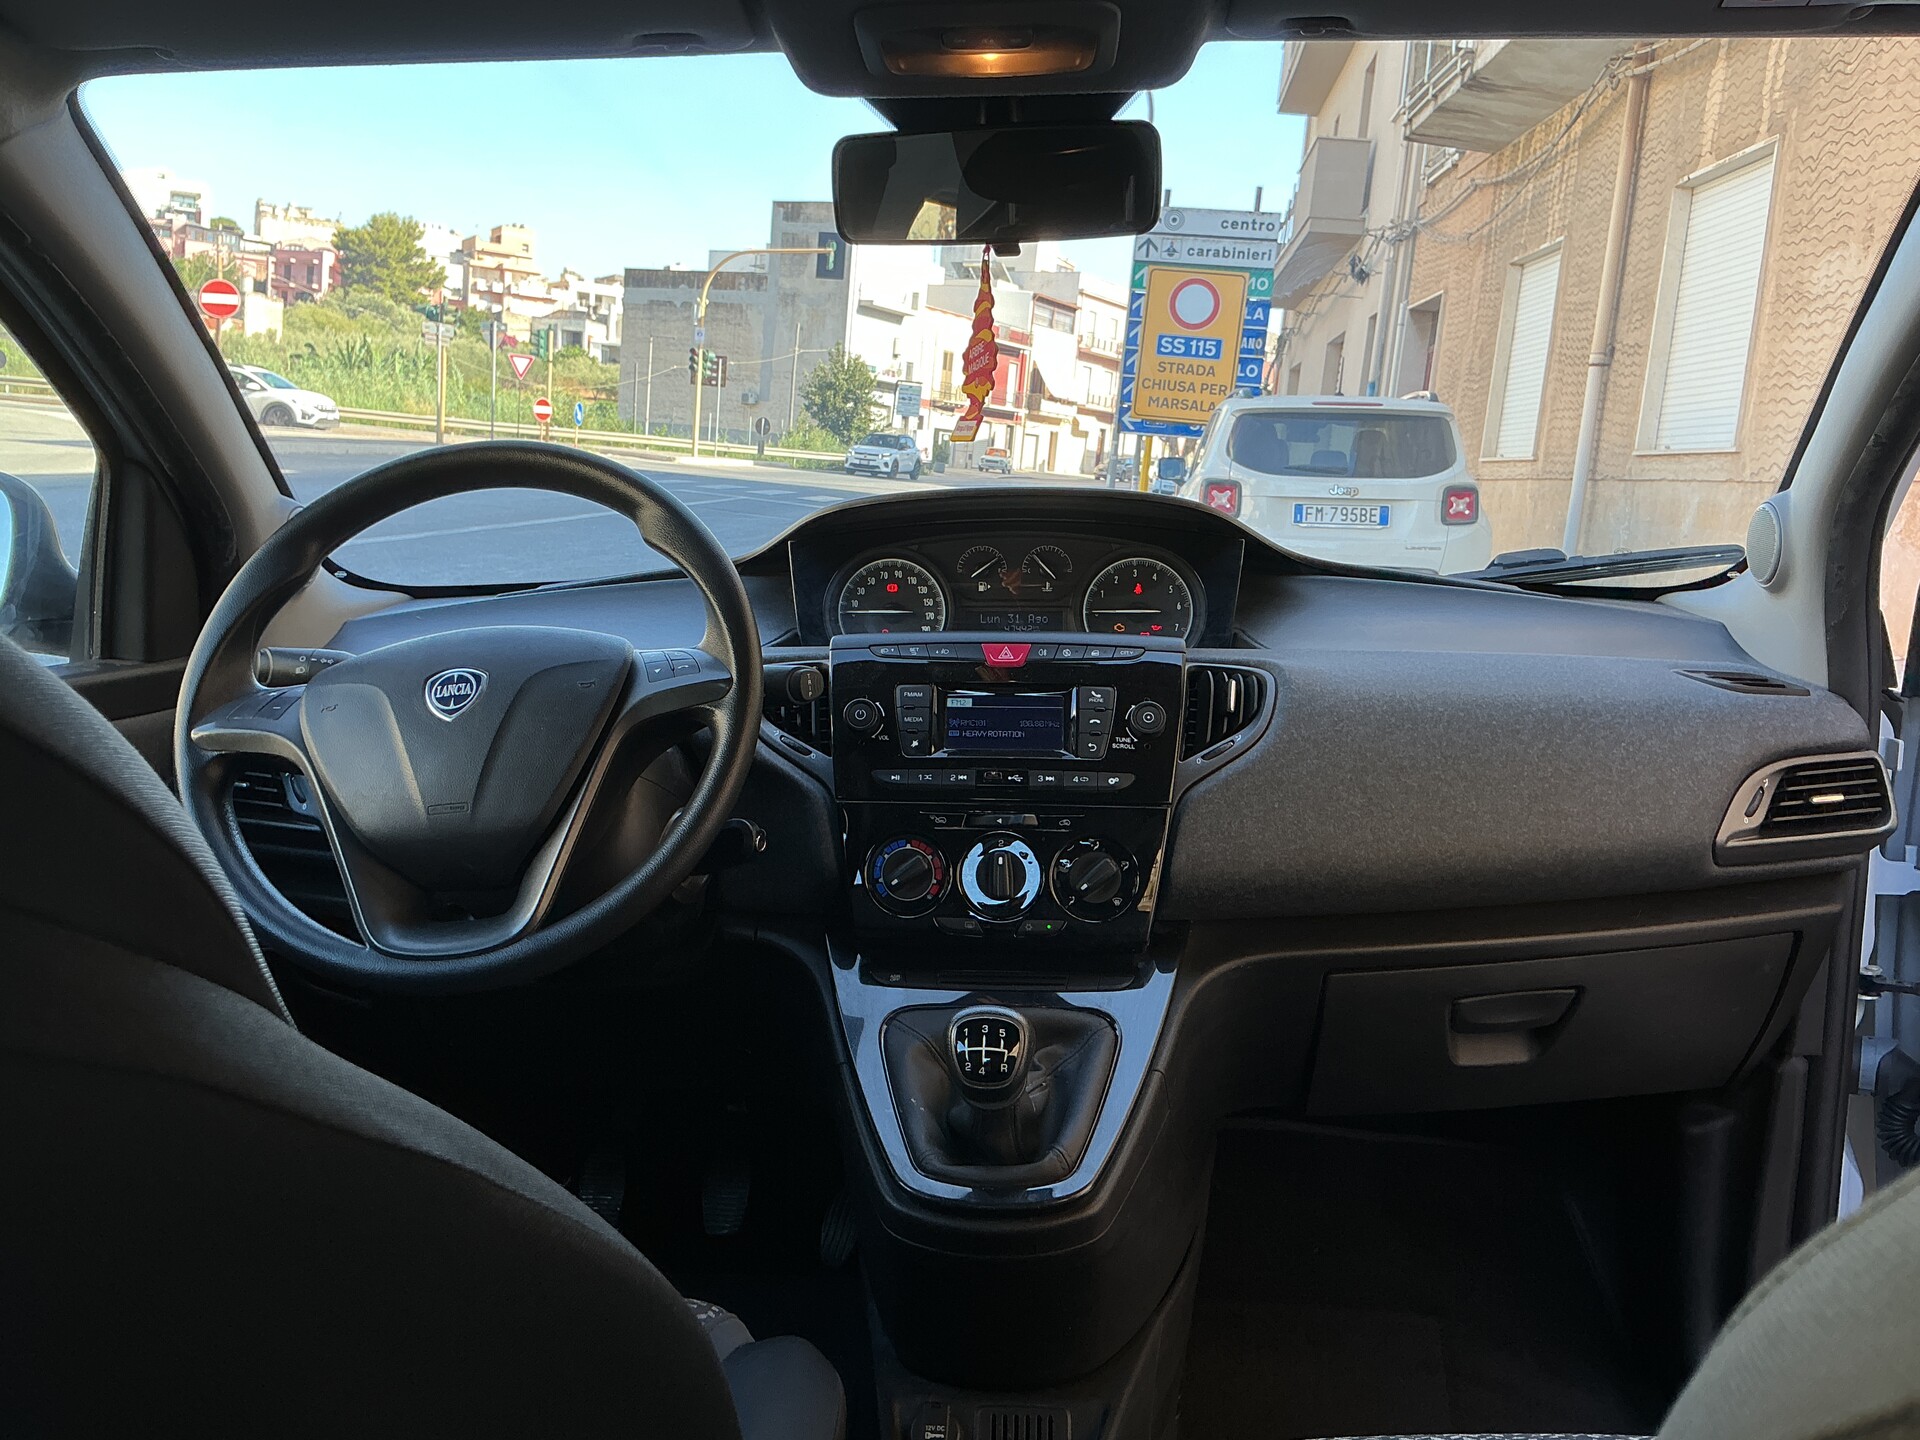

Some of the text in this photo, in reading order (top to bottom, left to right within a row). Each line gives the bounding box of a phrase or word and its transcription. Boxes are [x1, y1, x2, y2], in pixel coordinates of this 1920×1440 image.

[1220, 219, 1276, 231] centro
[1187, 246, 1272, 261] carabinieri
[1160, 337, 1217, 356] SS 115
[1157, 361, 1215, 377] STRADA
[1142, 378, 1228, 397] CHIUSA PER
[1147, 396, 1217, 412] MARSALA
[1329, 484, 1359, 497] Jeep
[894, 570, 902, 578] 90
[1133, 569, 1137, 578] 3
[1152, 573, 1157, 581] 4
[908, 576, 917, 585] 110
[1114, 576, 1118, 584] 2
[1169, 585, 1173, 593] 5
[1177, 602, 1181, 610] 6
[980, 614, 1000, 623] Lun
[1008, 614, 1019, 623] 31
[436, 683, 472, 698] LANCIA
[964, 1028, 968, 1036] 1
[999, 1029, 1006, 1037] 5
[965, 1063, 1008, 1075] 2 4 R
